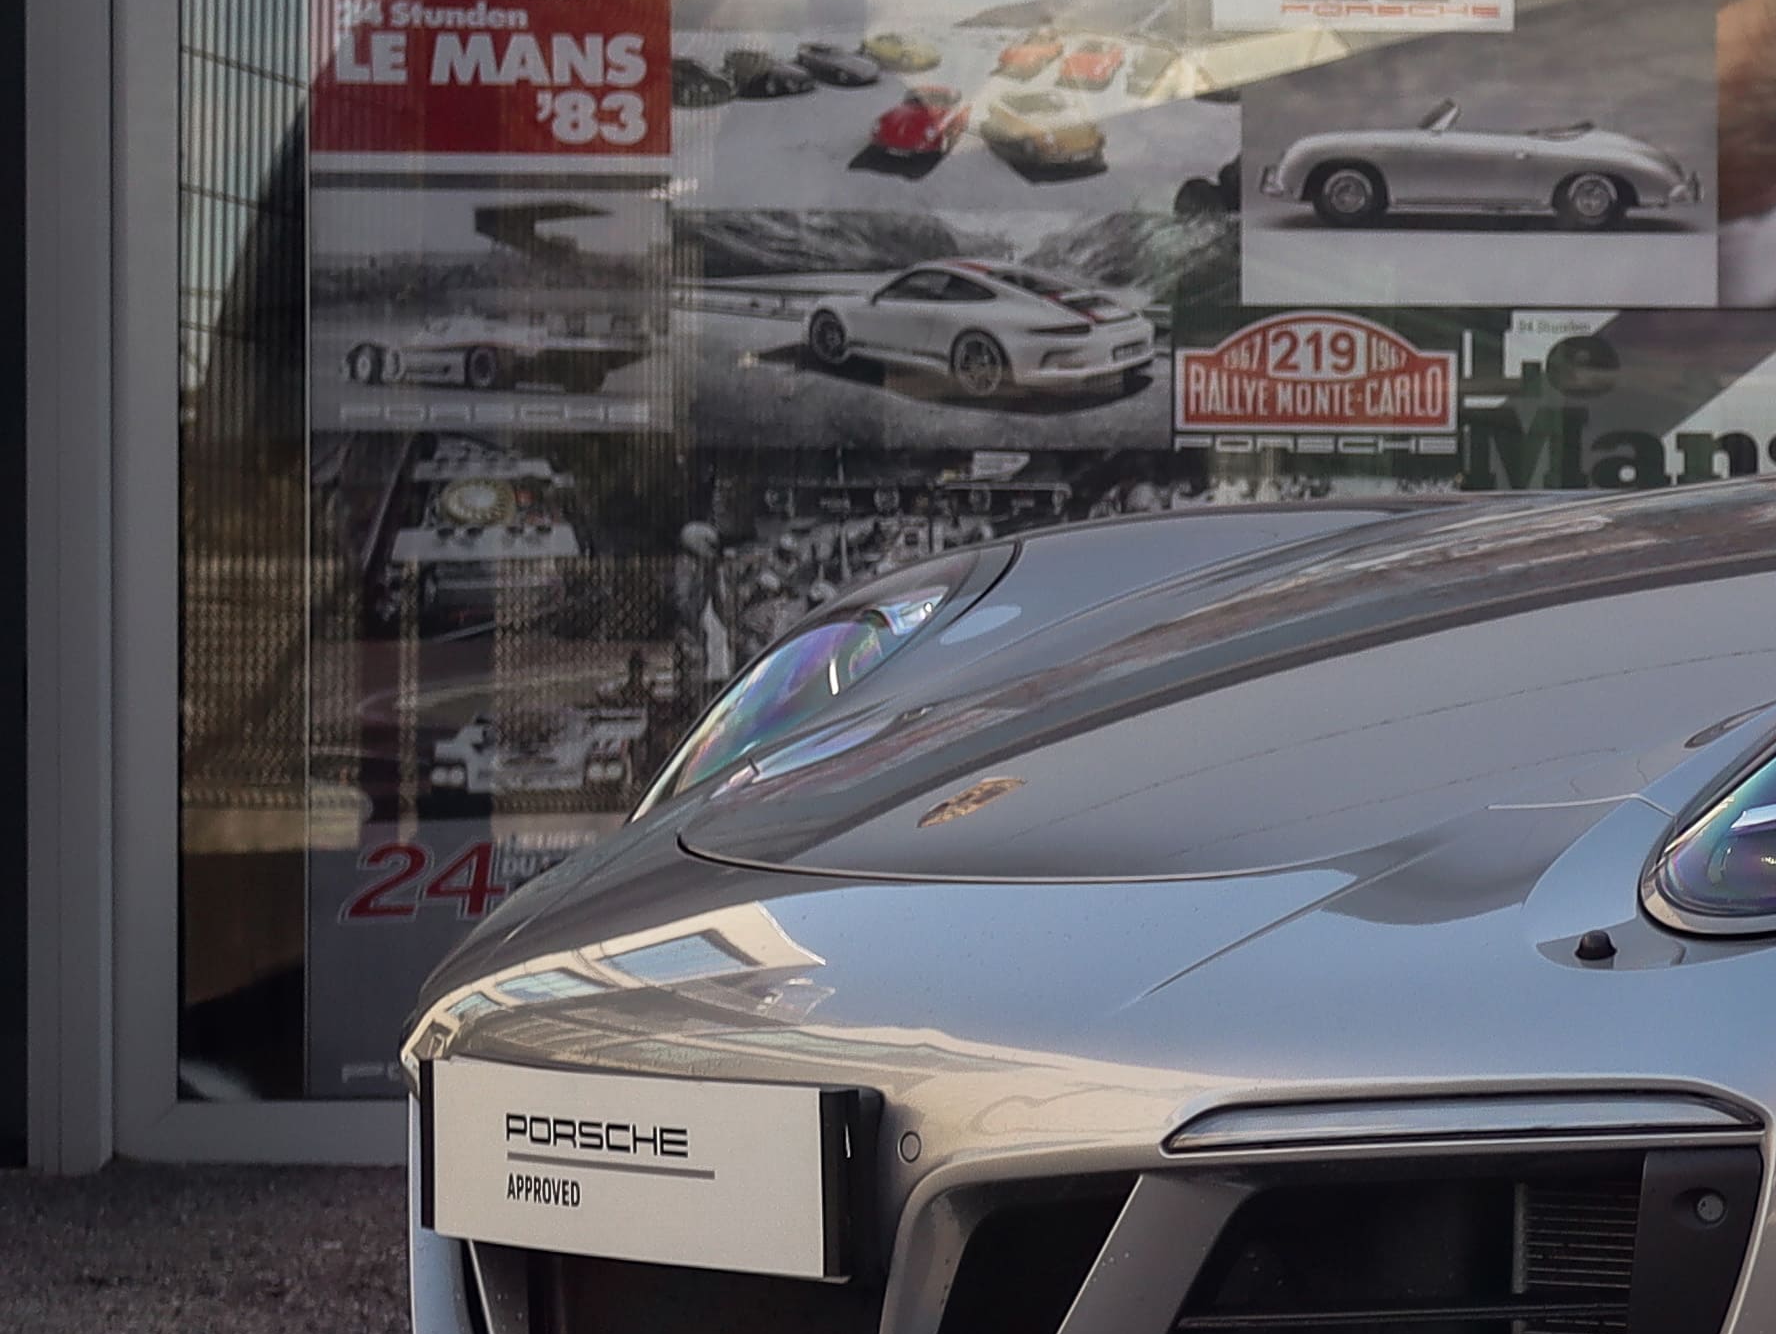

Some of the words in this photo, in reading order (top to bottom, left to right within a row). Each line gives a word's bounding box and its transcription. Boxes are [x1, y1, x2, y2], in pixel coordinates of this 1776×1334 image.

[390, 0, 529, 29] Stunden
[334, 31, 408, 85] LE
[430, 32, 648, 87] MANS
[1271, 329, 1357, 374] 219
[1189, 364, 1268, 416] RALLYE
[1174, 433, 1458, 454] PORSCHE
[338, 838, 508, 924] 24
[505, 1113, 689, 1159] PORSCHE
[506, 1172, 582, 1207] APPROVED
